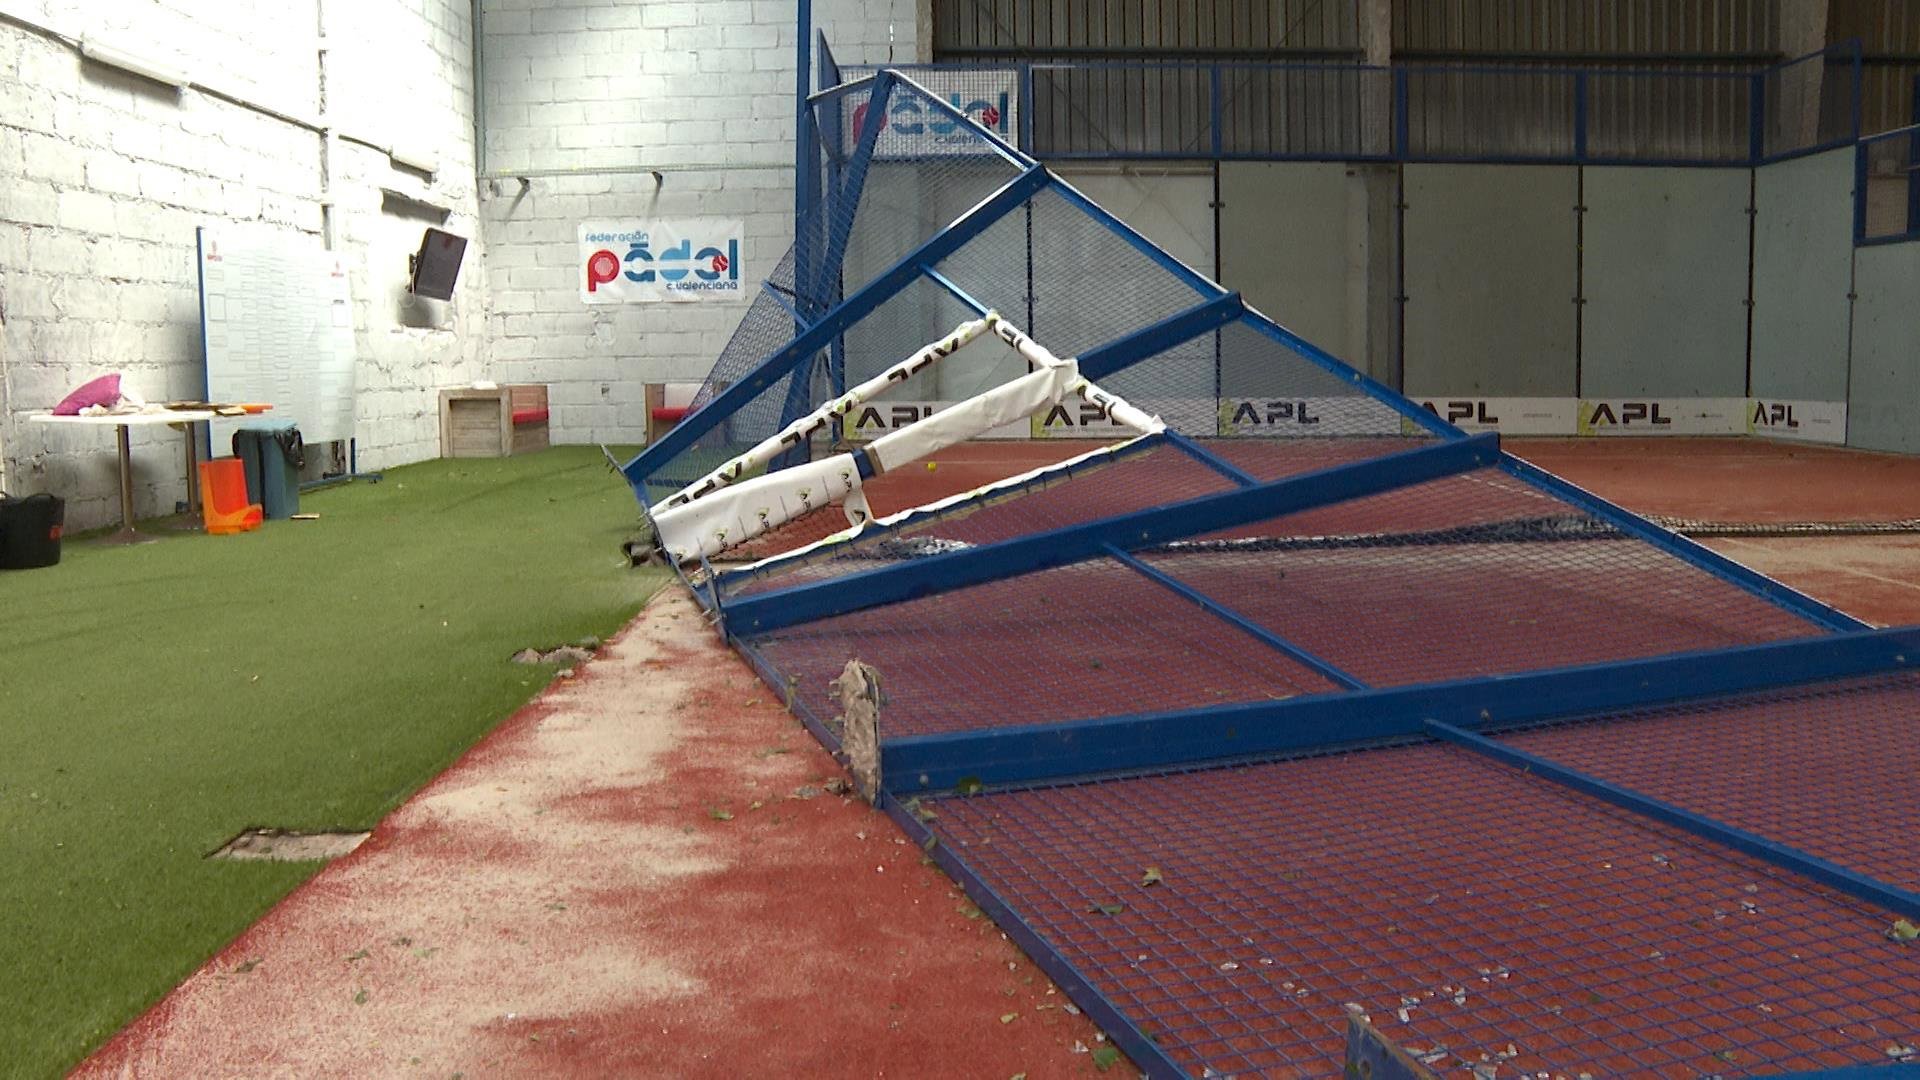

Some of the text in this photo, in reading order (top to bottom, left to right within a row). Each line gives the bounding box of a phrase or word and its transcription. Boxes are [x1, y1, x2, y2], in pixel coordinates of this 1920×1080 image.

[1232, 402, 1320, 424] APL
[1590, 403, 1671, 424] APL
[1753, 401, 1798, 428] APL
